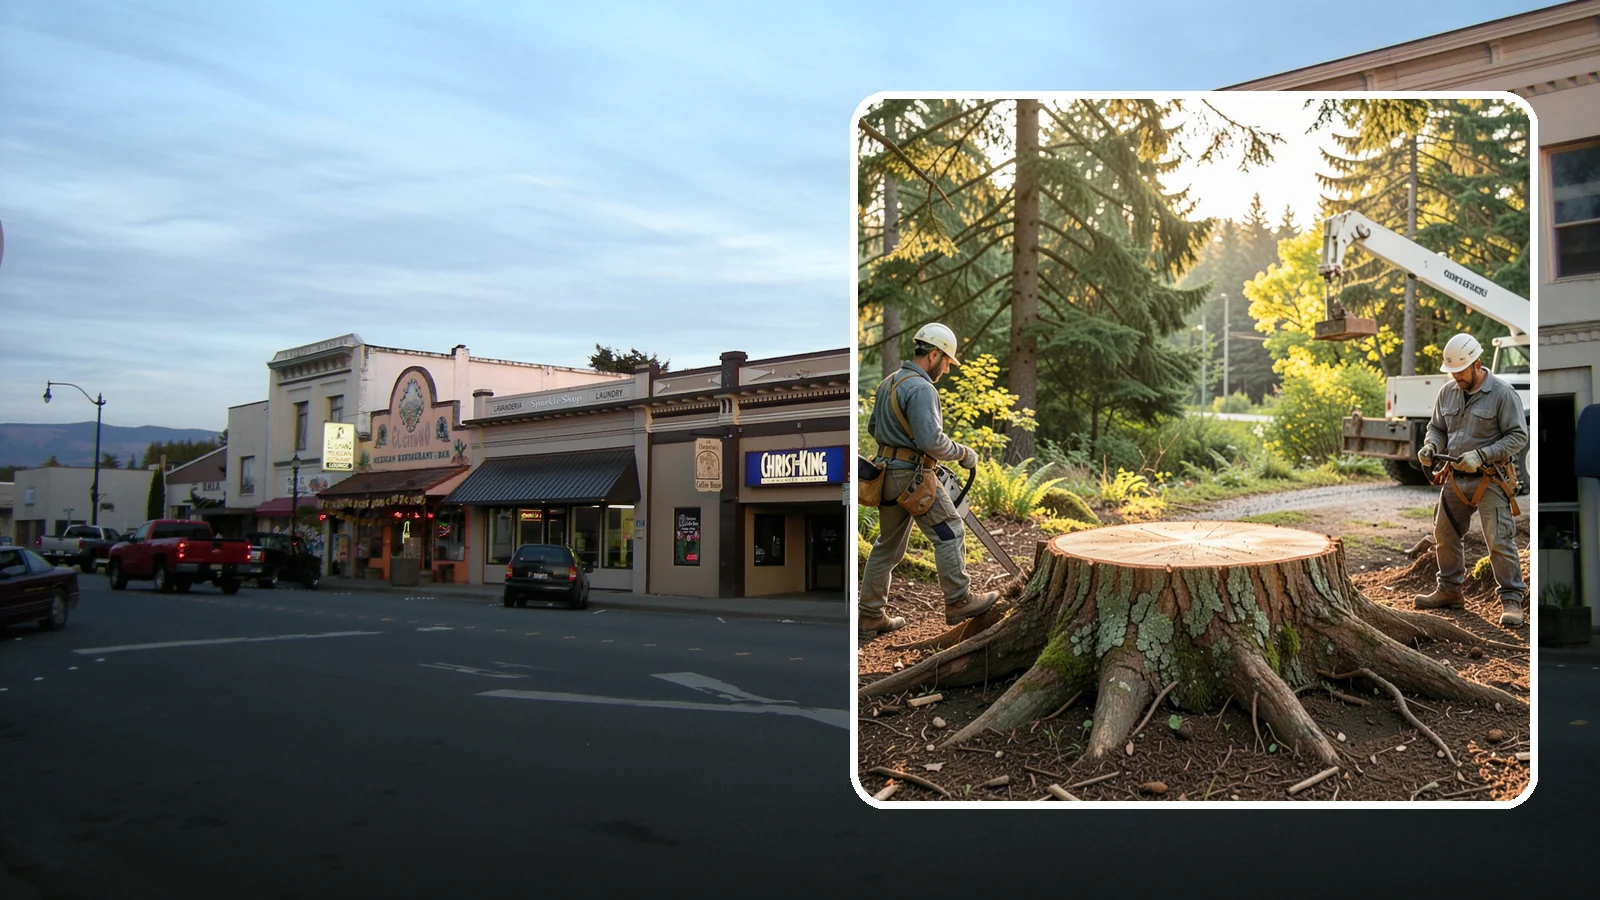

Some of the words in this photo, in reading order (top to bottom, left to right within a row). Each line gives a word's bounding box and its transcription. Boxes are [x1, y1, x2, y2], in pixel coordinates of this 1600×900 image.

[530, 397, 561, 408] Sparkle
[562, 394, 582, 405] Shop
[596, 389, 624, 399] LAUNDRY
[493, 402, 522, 412] LAVANDERIA
[373, 455, 396, 464] MEXICAN
[397, 451, 434, 462] RESTAURANT
[438, 450, 450, 459] BAR
[761, 452, 798, 478] CHRIST
[799, 450, 827, 476] KING
